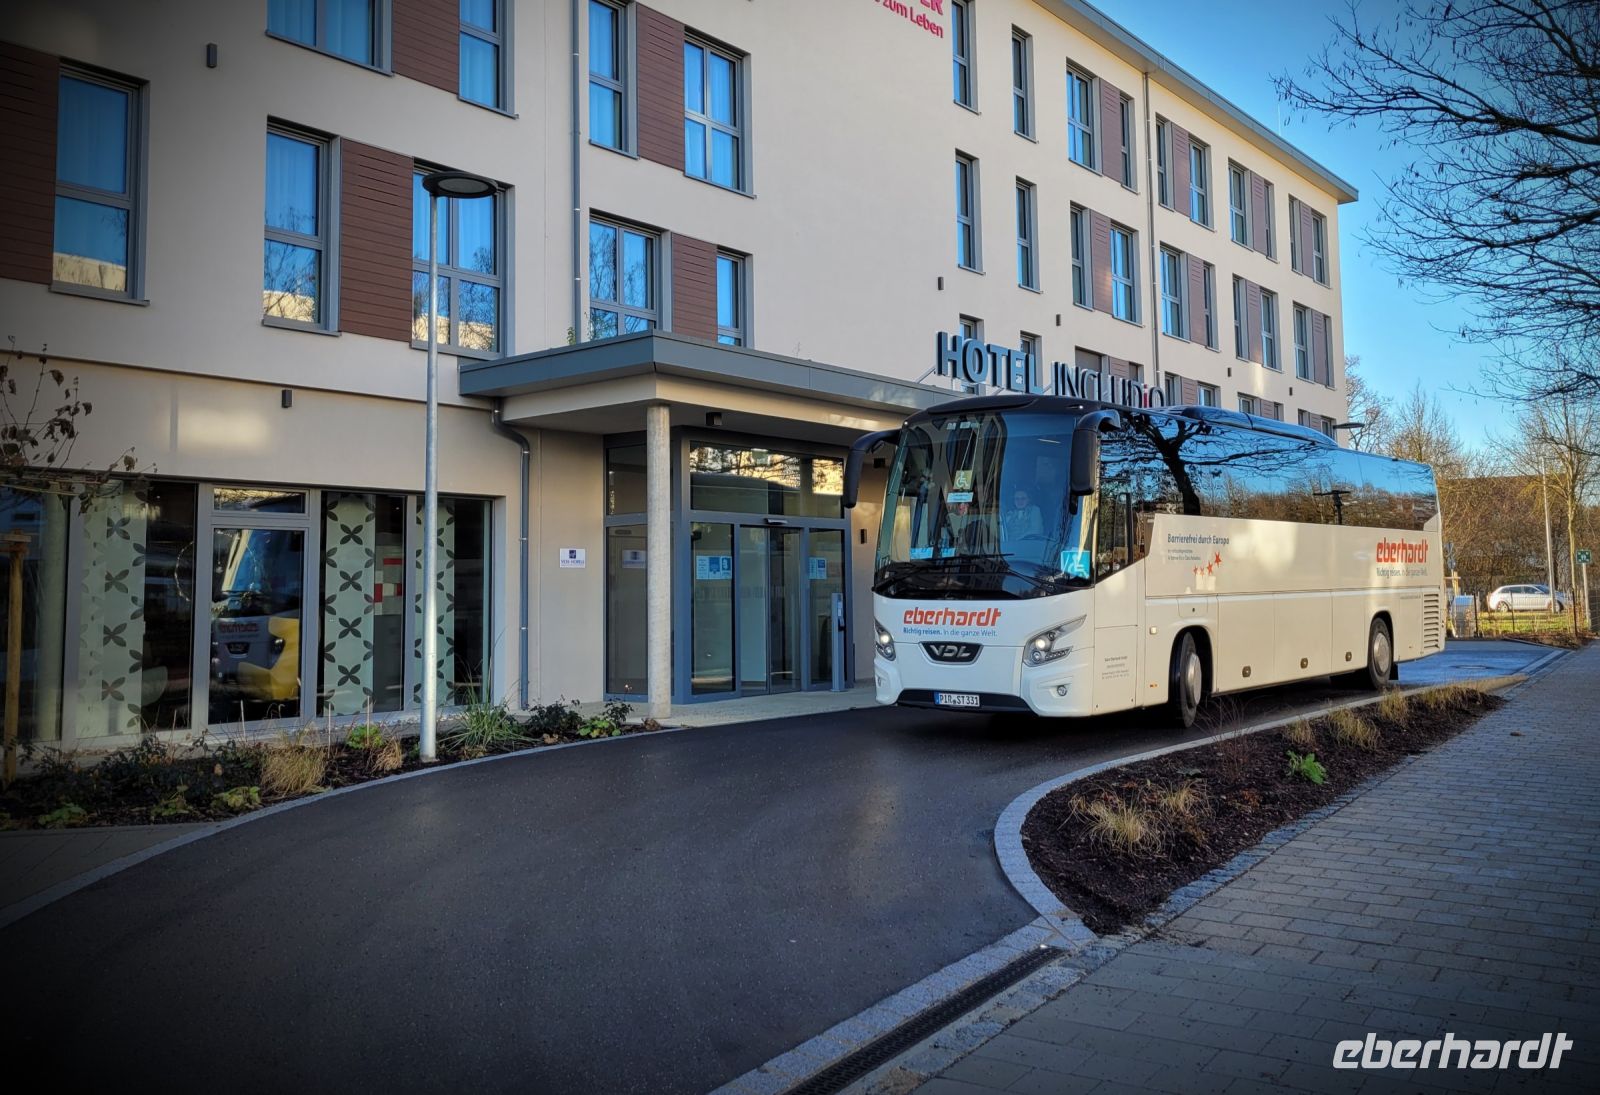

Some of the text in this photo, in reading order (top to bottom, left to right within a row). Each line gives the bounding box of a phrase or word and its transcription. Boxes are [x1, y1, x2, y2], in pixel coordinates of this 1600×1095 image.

[910, 6, 944, 38] Leben
[936, 331, 1044, 394] HOTEL
[1167, 533, 1230, 546] Barrierefrei durch Europa
[1376, 537, 1428, 563] eberhardt
[903, 607, 1001, 627] eberhardt
[903, 627, 922, 636] Richtig
[960, 630, 979, 638] ganze
[930, 645, 971, 657] VDL
